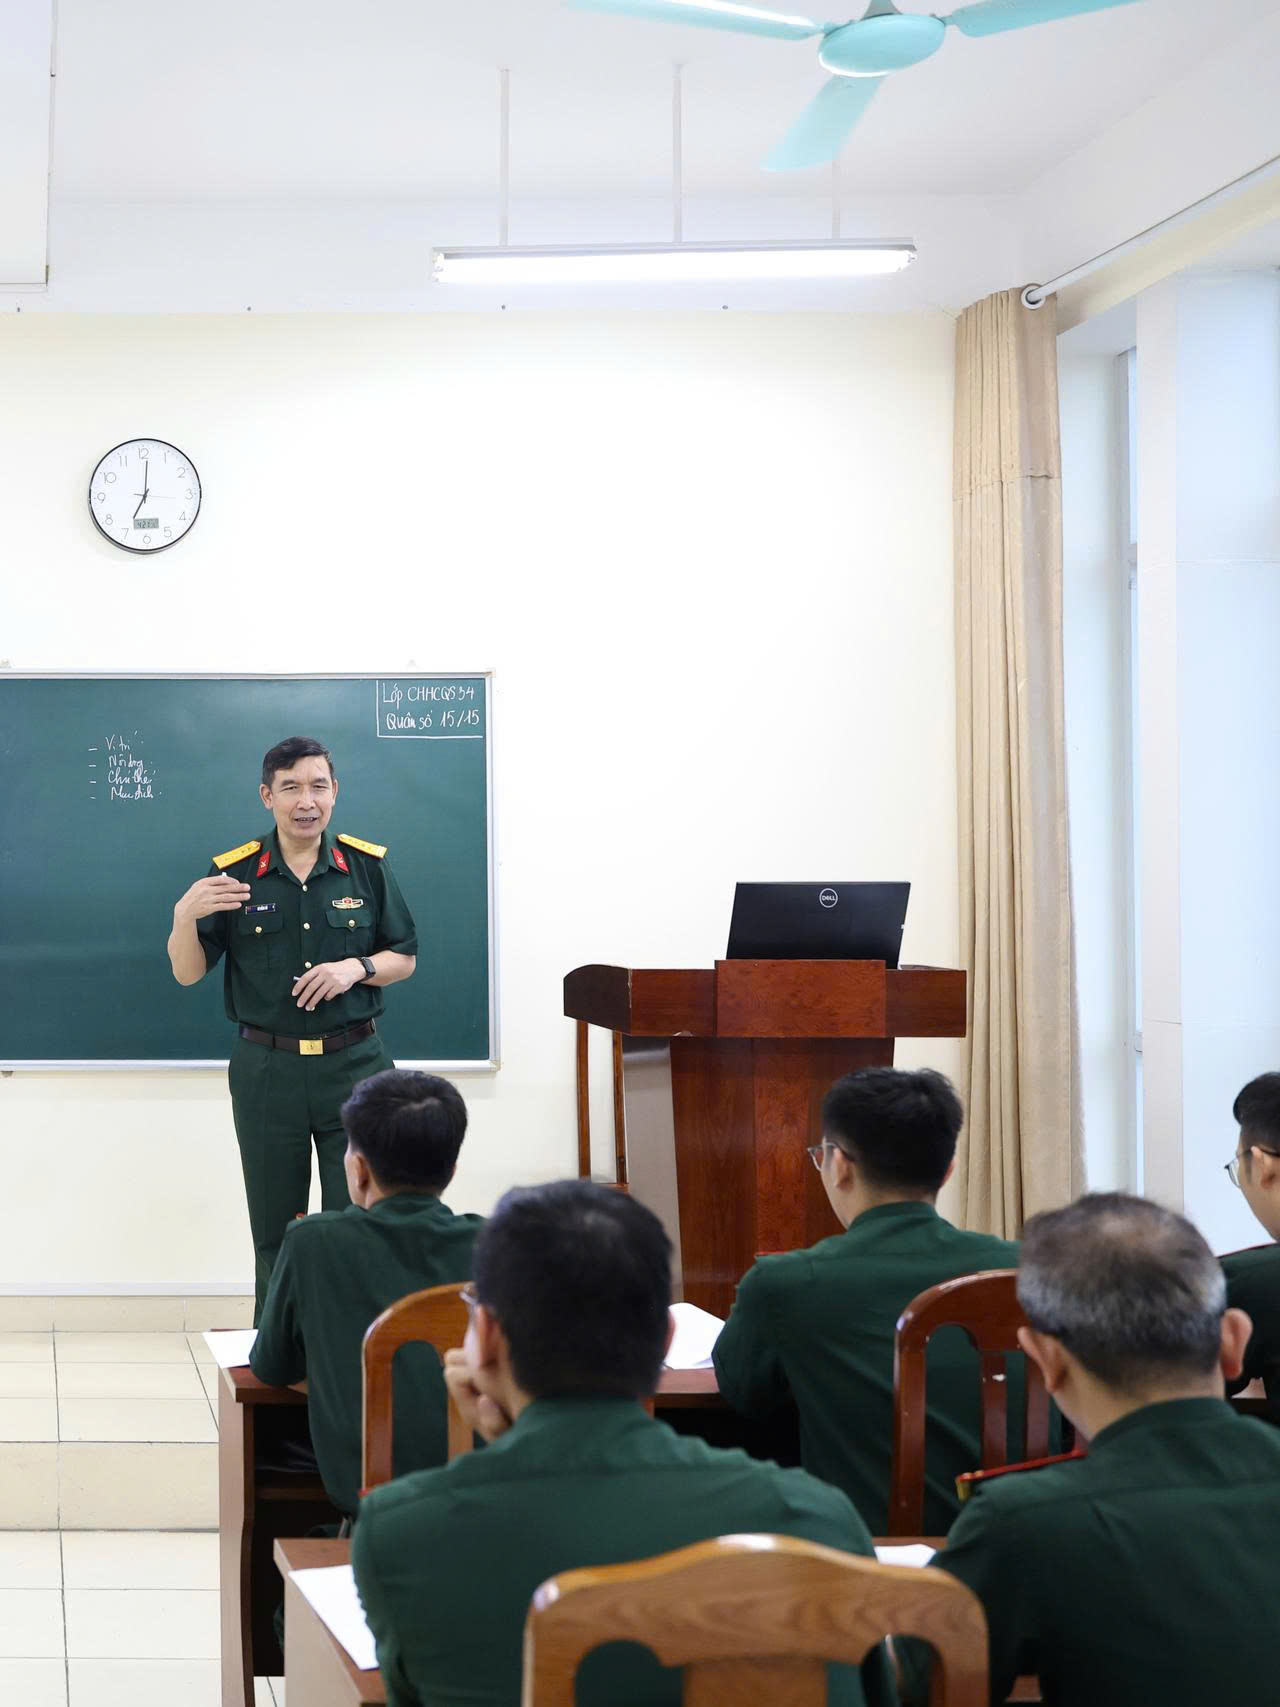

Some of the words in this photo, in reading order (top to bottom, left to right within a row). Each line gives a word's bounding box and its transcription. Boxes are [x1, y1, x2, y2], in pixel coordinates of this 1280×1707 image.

[138, 448, 150, 460] 12
[119, 455, 128, 467] 11
[103, 471, 117, 484] 10
[176, 467, 186, 478] 2
[97, 492, 106, 504] 9
[185, 488, 194, 500] 3
[105, 513, 114, 526] 8
[178, 511, 186, 521] 4
[121, 527, 129, 540] 7
[163, 527, 172, 538] 5
[142, 533, 152, 545] 6
[383, 682, 403, 710] Lớp
[386, 712, 416, 730] Quân
